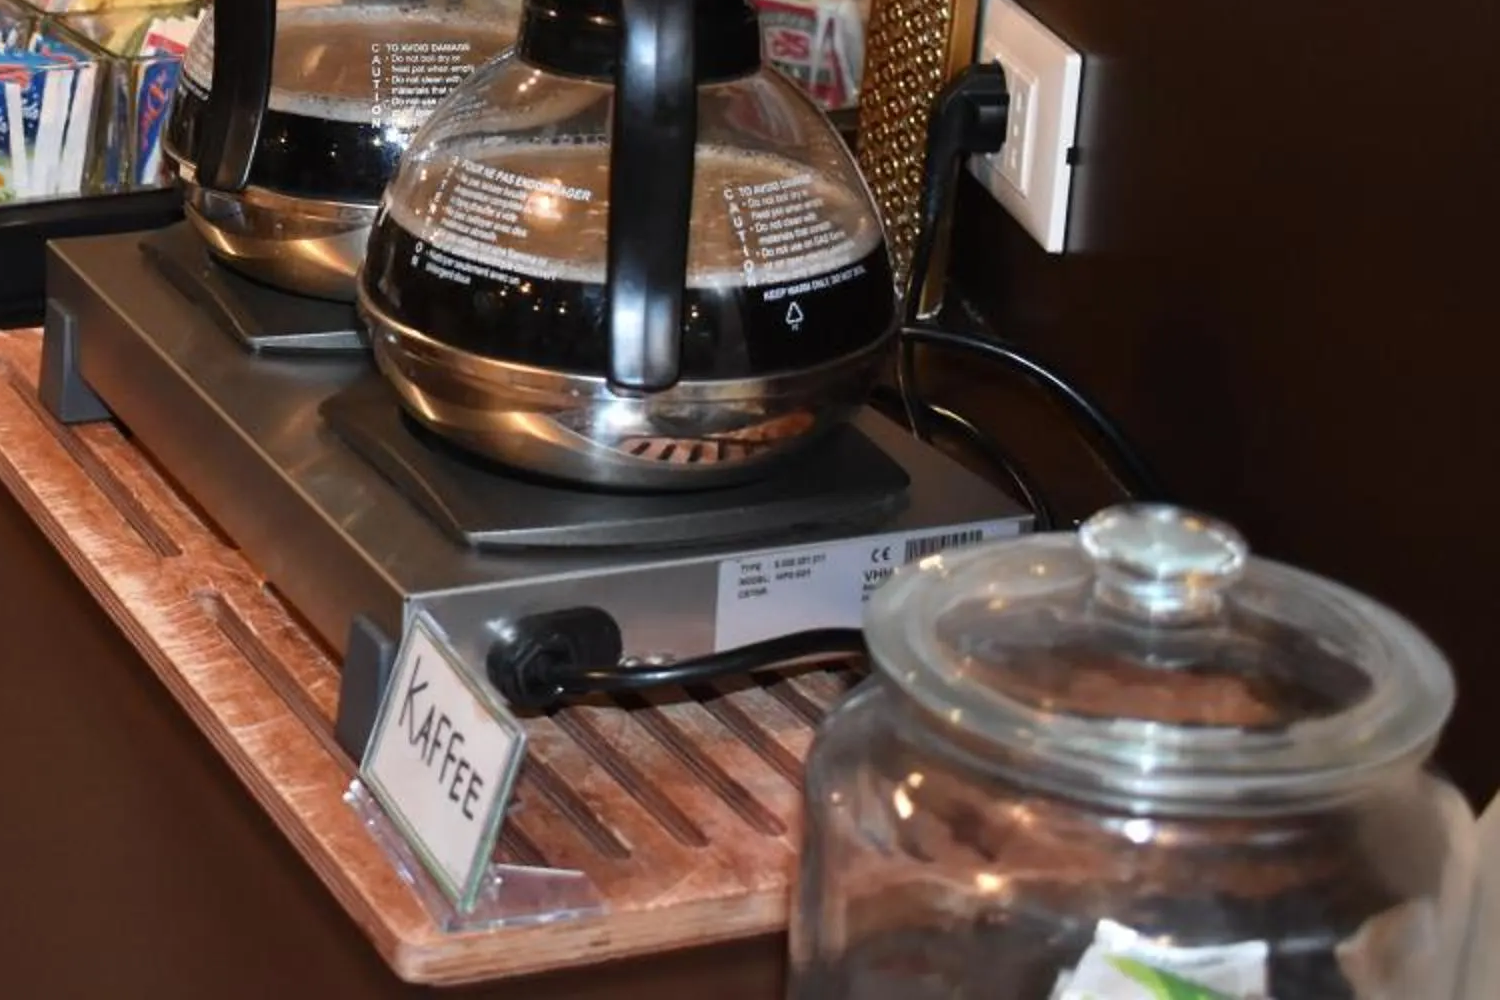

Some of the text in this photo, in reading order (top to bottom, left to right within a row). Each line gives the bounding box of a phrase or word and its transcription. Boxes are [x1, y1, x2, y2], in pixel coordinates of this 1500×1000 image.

[371, 43, 380, 128] CAUTION
[386, 43, 398, 51] TO
[723, 188, 756, 287] CAUTION
[398, 654, 484, 822] KAFFEE
